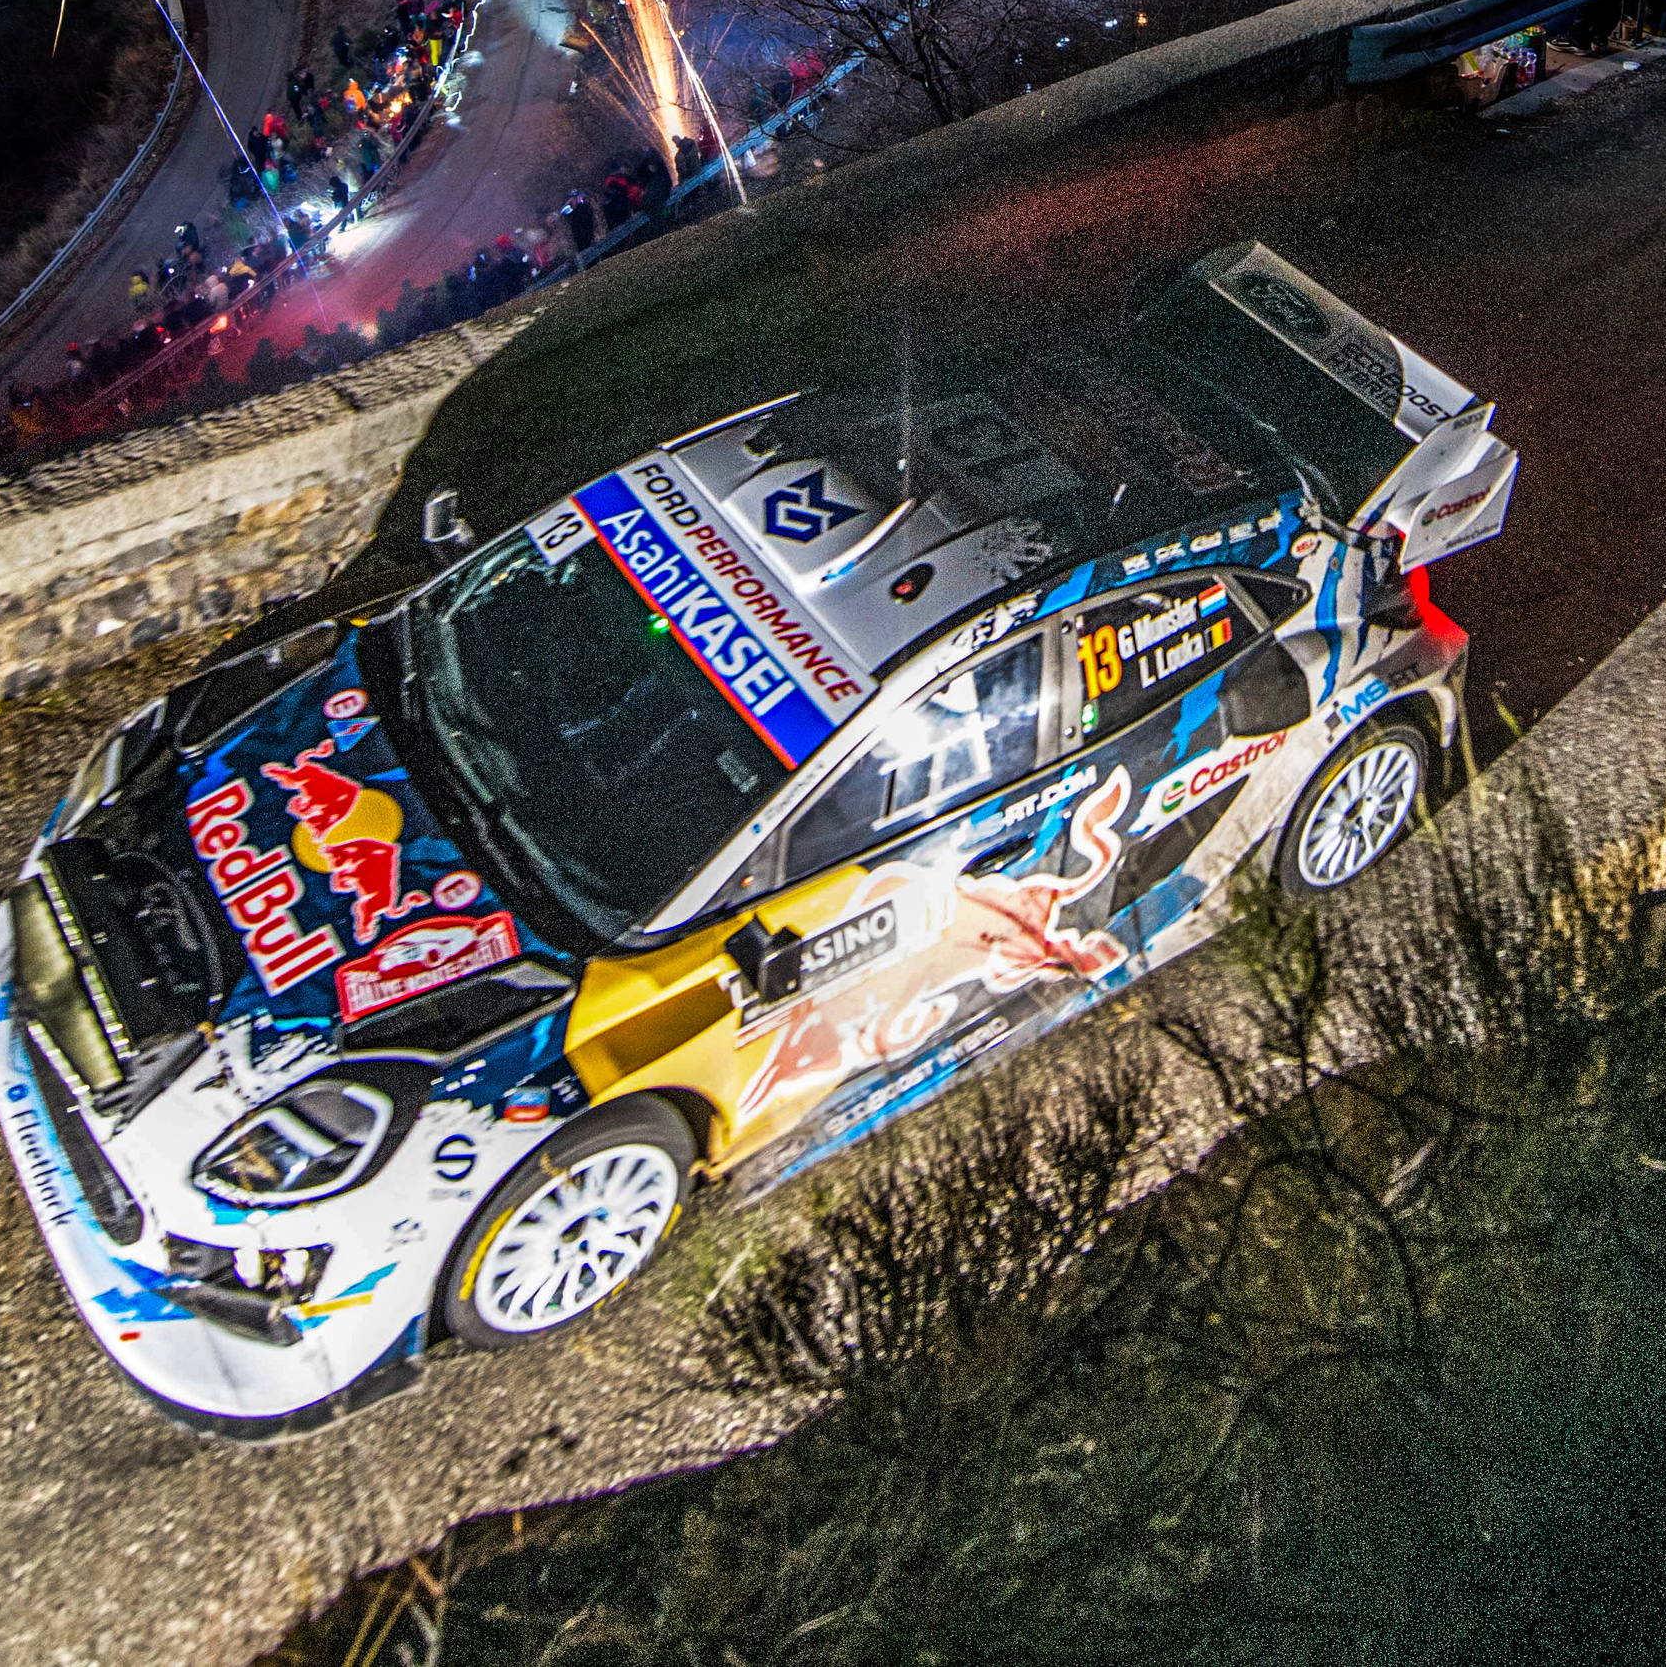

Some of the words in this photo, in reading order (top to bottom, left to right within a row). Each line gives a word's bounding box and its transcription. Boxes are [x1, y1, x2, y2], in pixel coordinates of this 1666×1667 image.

[537, 511, 583, 551] 13
[1435, 488, 1492, 522] Castrol
[634, 463, 699, 528] FORD
[685, 524, 864, 703] PERFORMANCE
[1118, 633, 1134, 661] G
[1132, 594, 1199, 651] Munster
[1139, 656, 1156, 691] L
[1156, 629, 1206, 681] Louka
[1077, 624, 1124, 702] 13
[1189, 730, 1288, 797] Castrol
